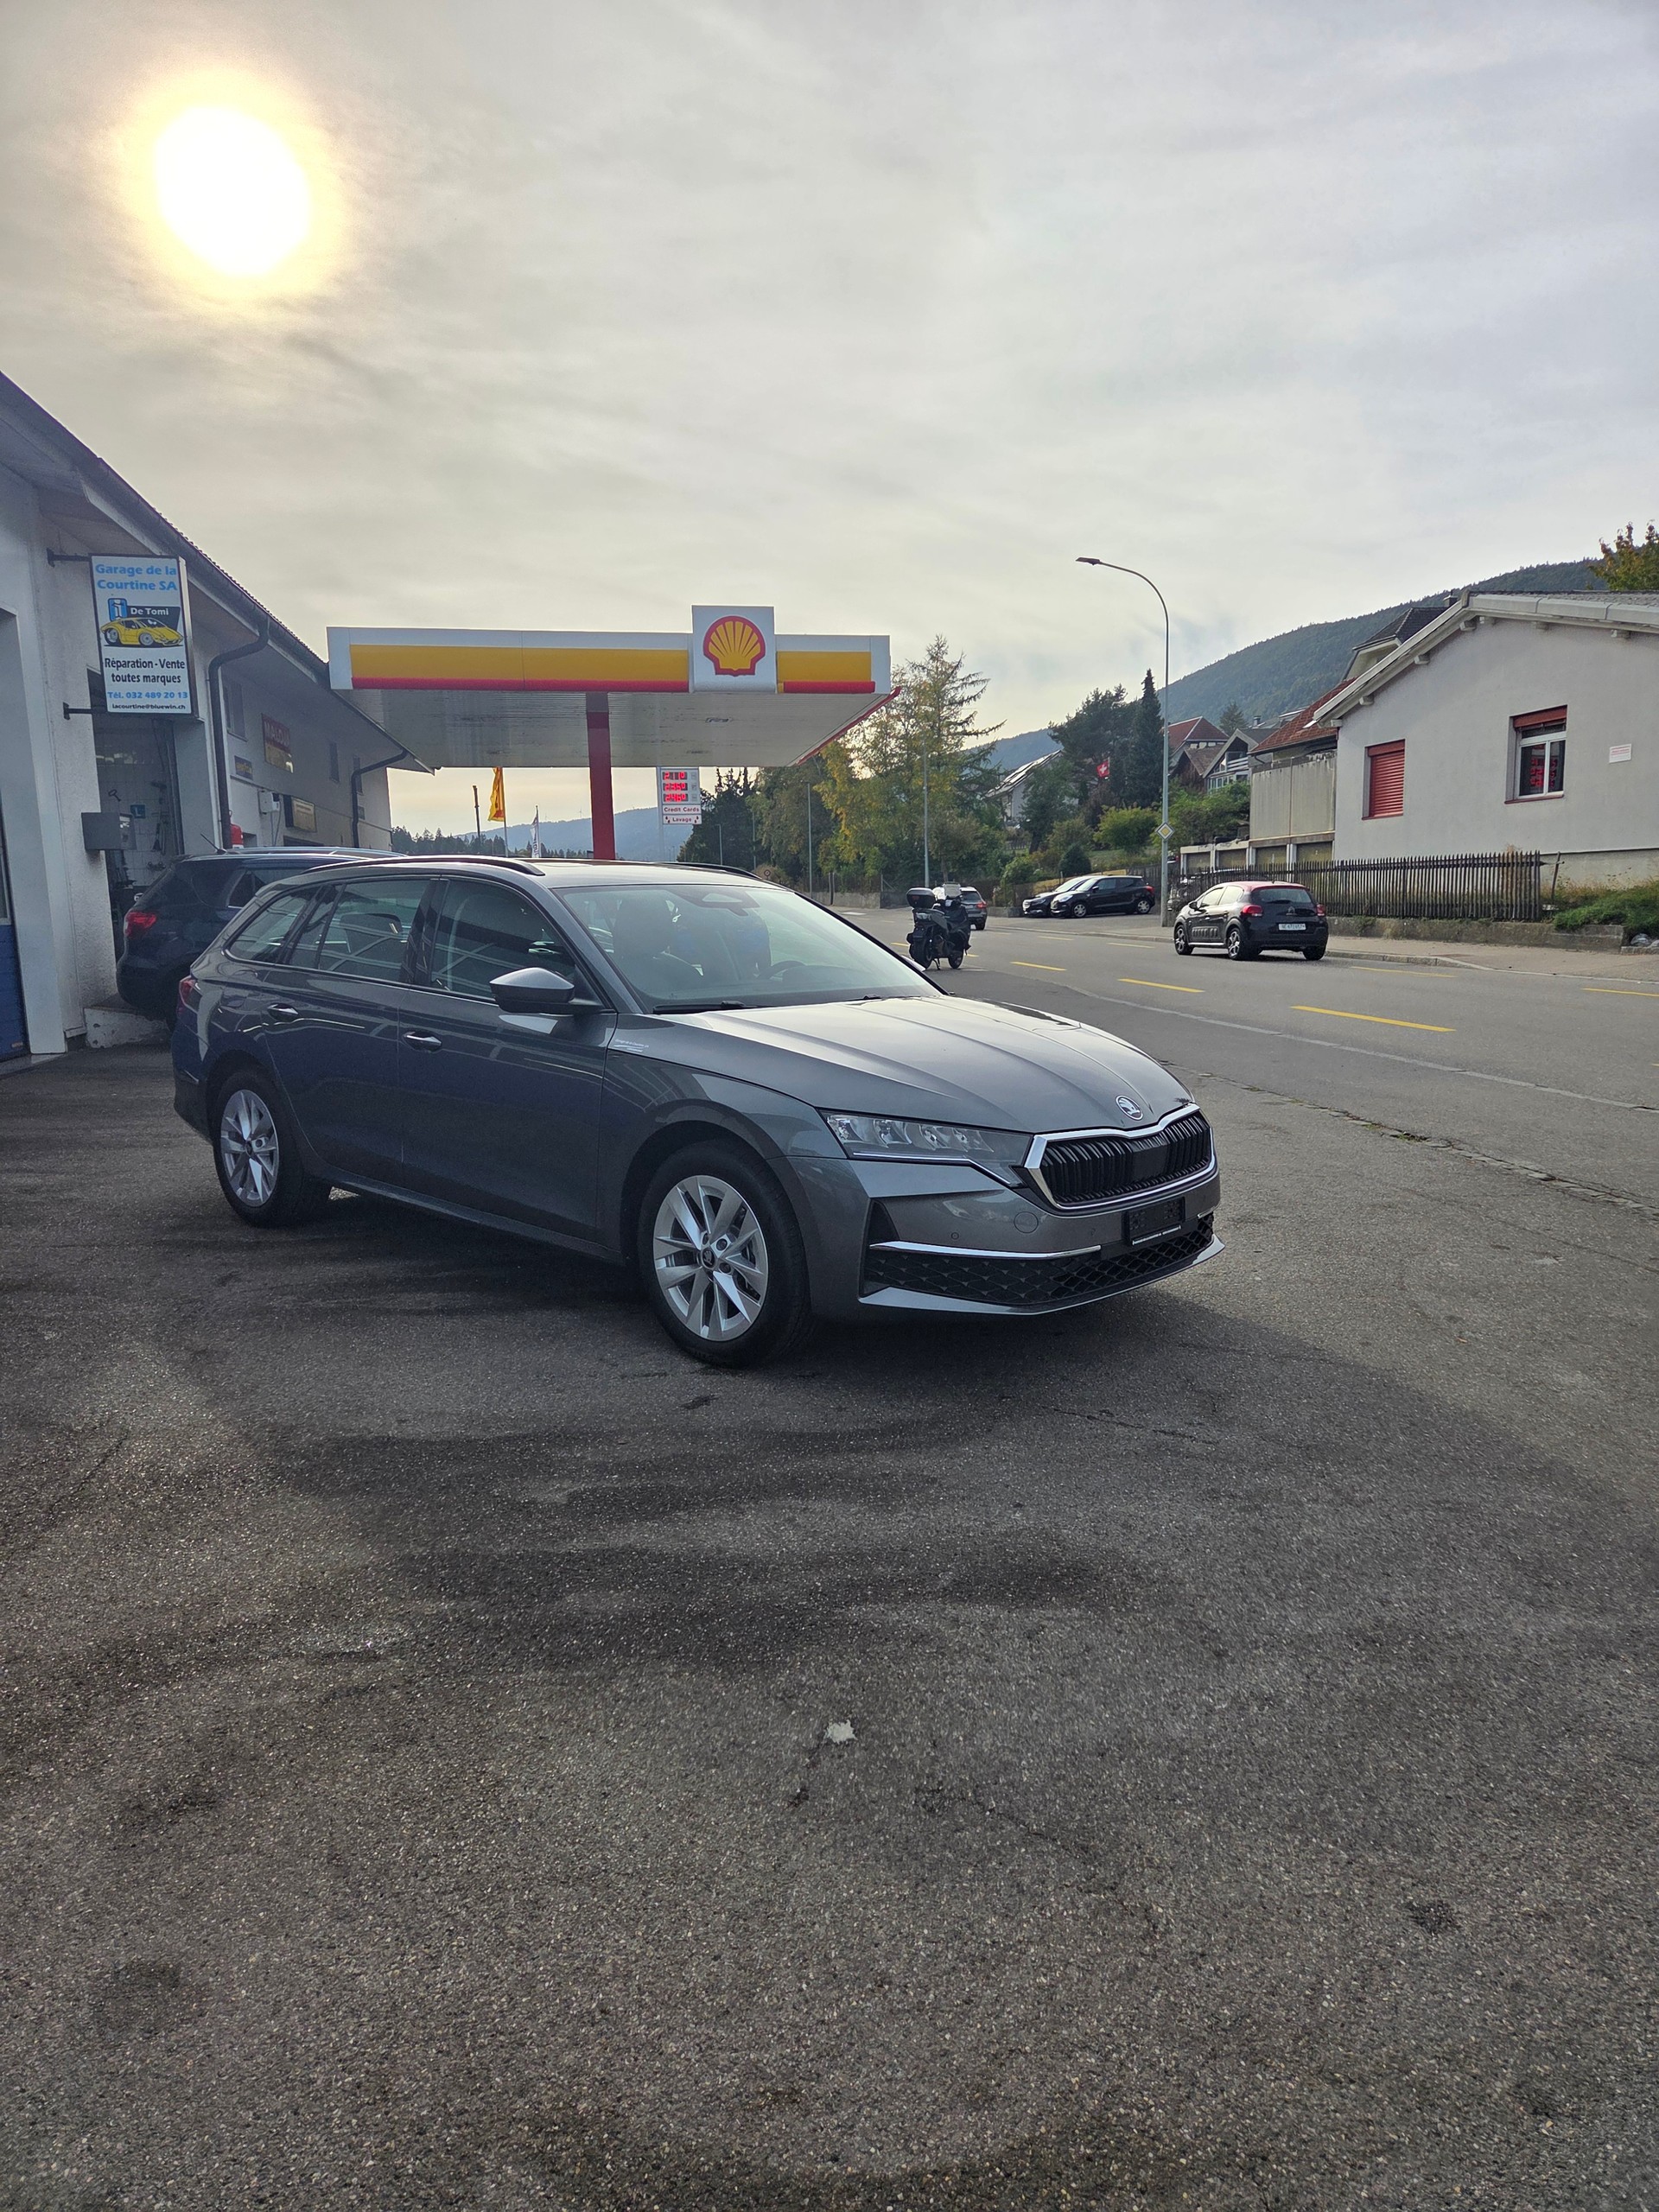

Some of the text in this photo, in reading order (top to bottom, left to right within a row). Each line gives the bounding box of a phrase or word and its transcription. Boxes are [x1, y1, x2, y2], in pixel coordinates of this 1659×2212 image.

[95, 563, 176, 577] Garage de la
[97, 579, 177, 591] Courtine SA
[144, 607, 168, 616] Tomi
[105, 658, 154, 671] Réparation
[159, 658, 185, 670] Vente
[111, 672, 181, 686] toutes marques
